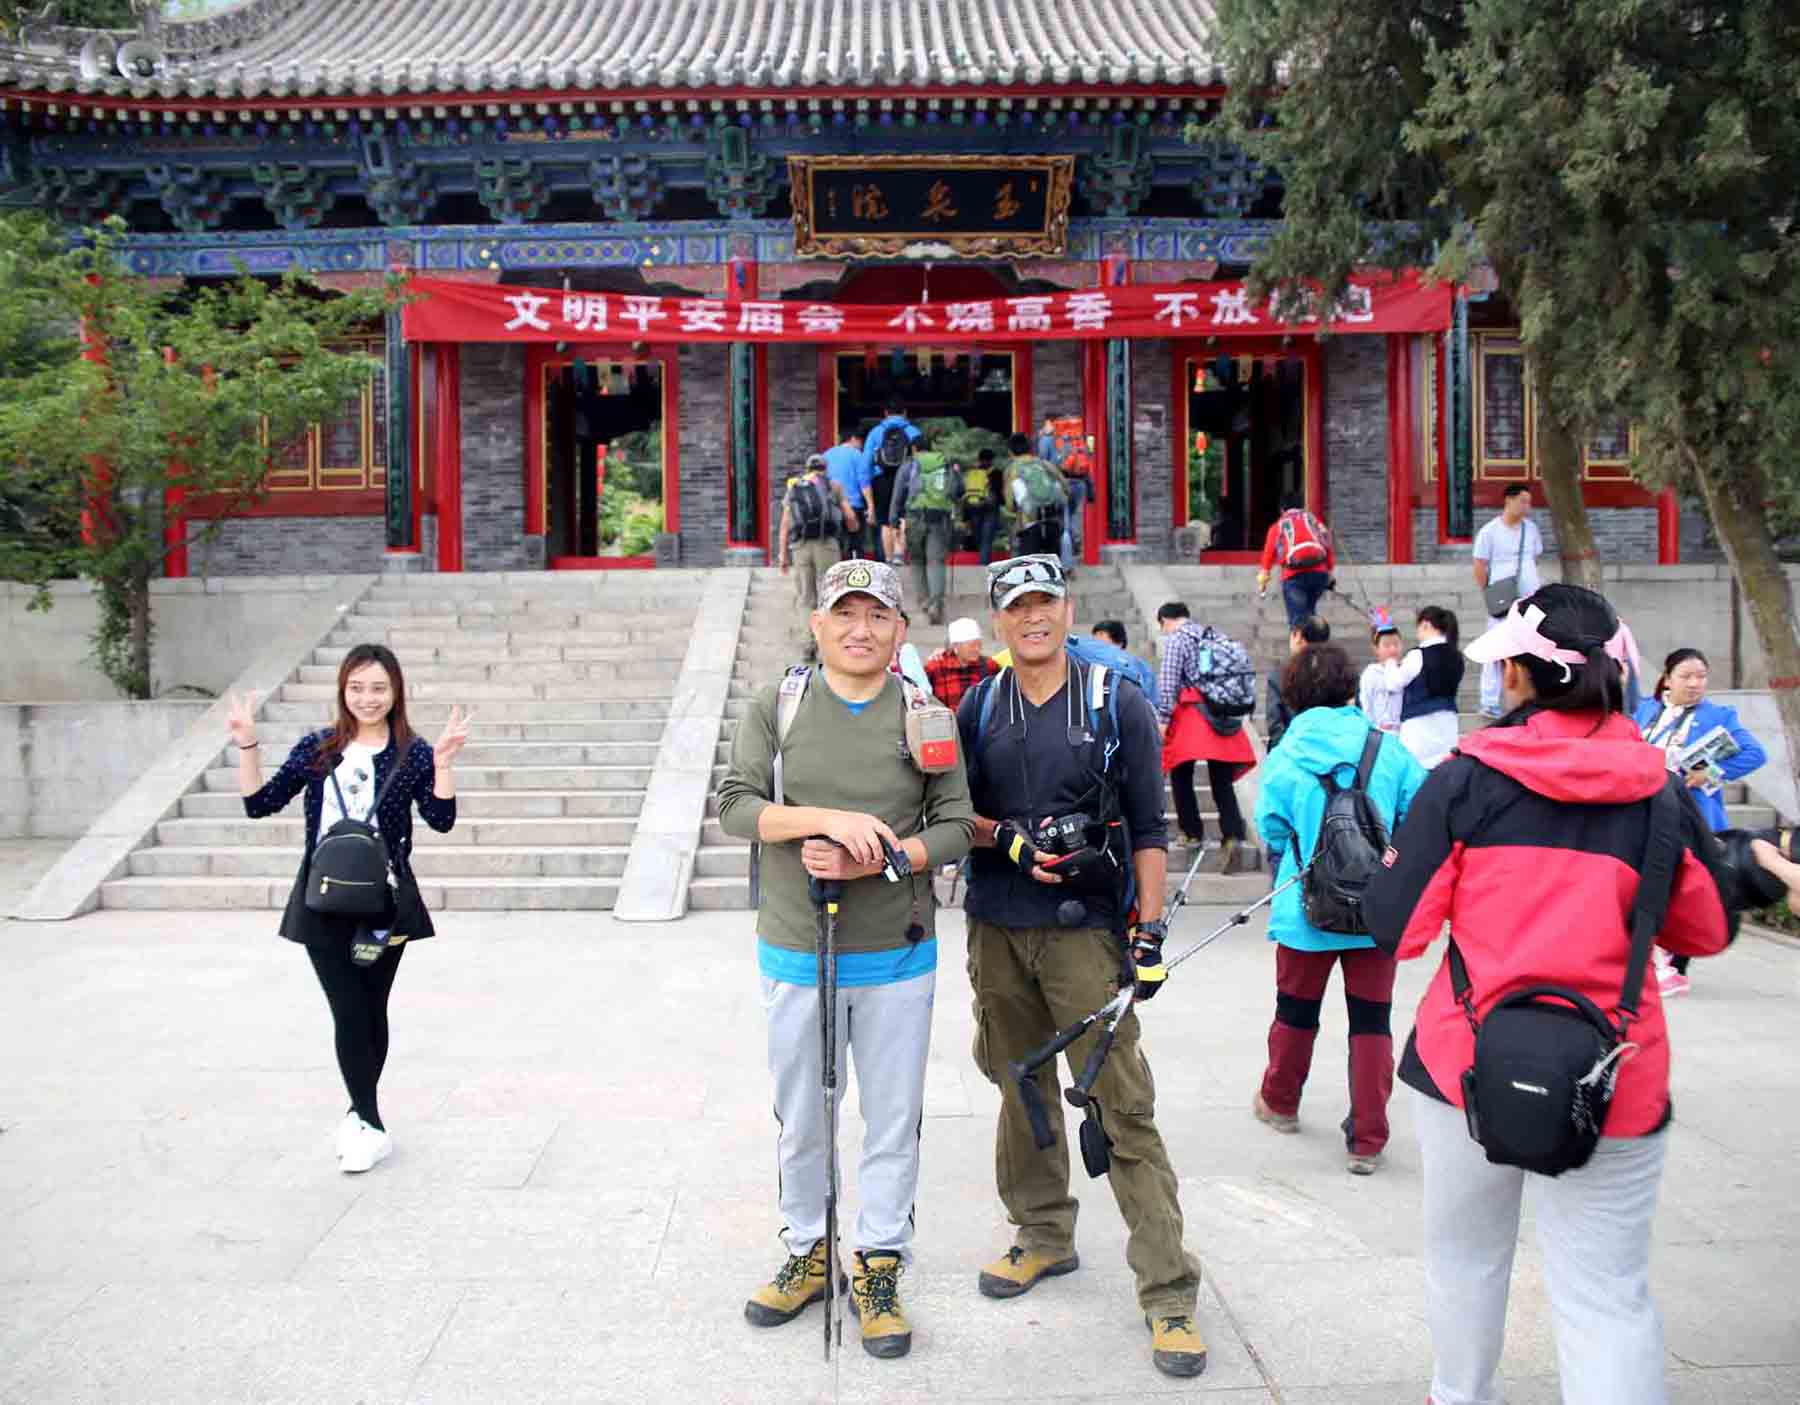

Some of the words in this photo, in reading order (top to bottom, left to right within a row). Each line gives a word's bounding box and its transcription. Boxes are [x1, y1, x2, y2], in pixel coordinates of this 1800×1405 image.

[503, 292, 846, 333] 文明平安庙会
[887, 291, 1114, 333] 不烧高香
[1153, 284, 1375, 327] 不放炮
